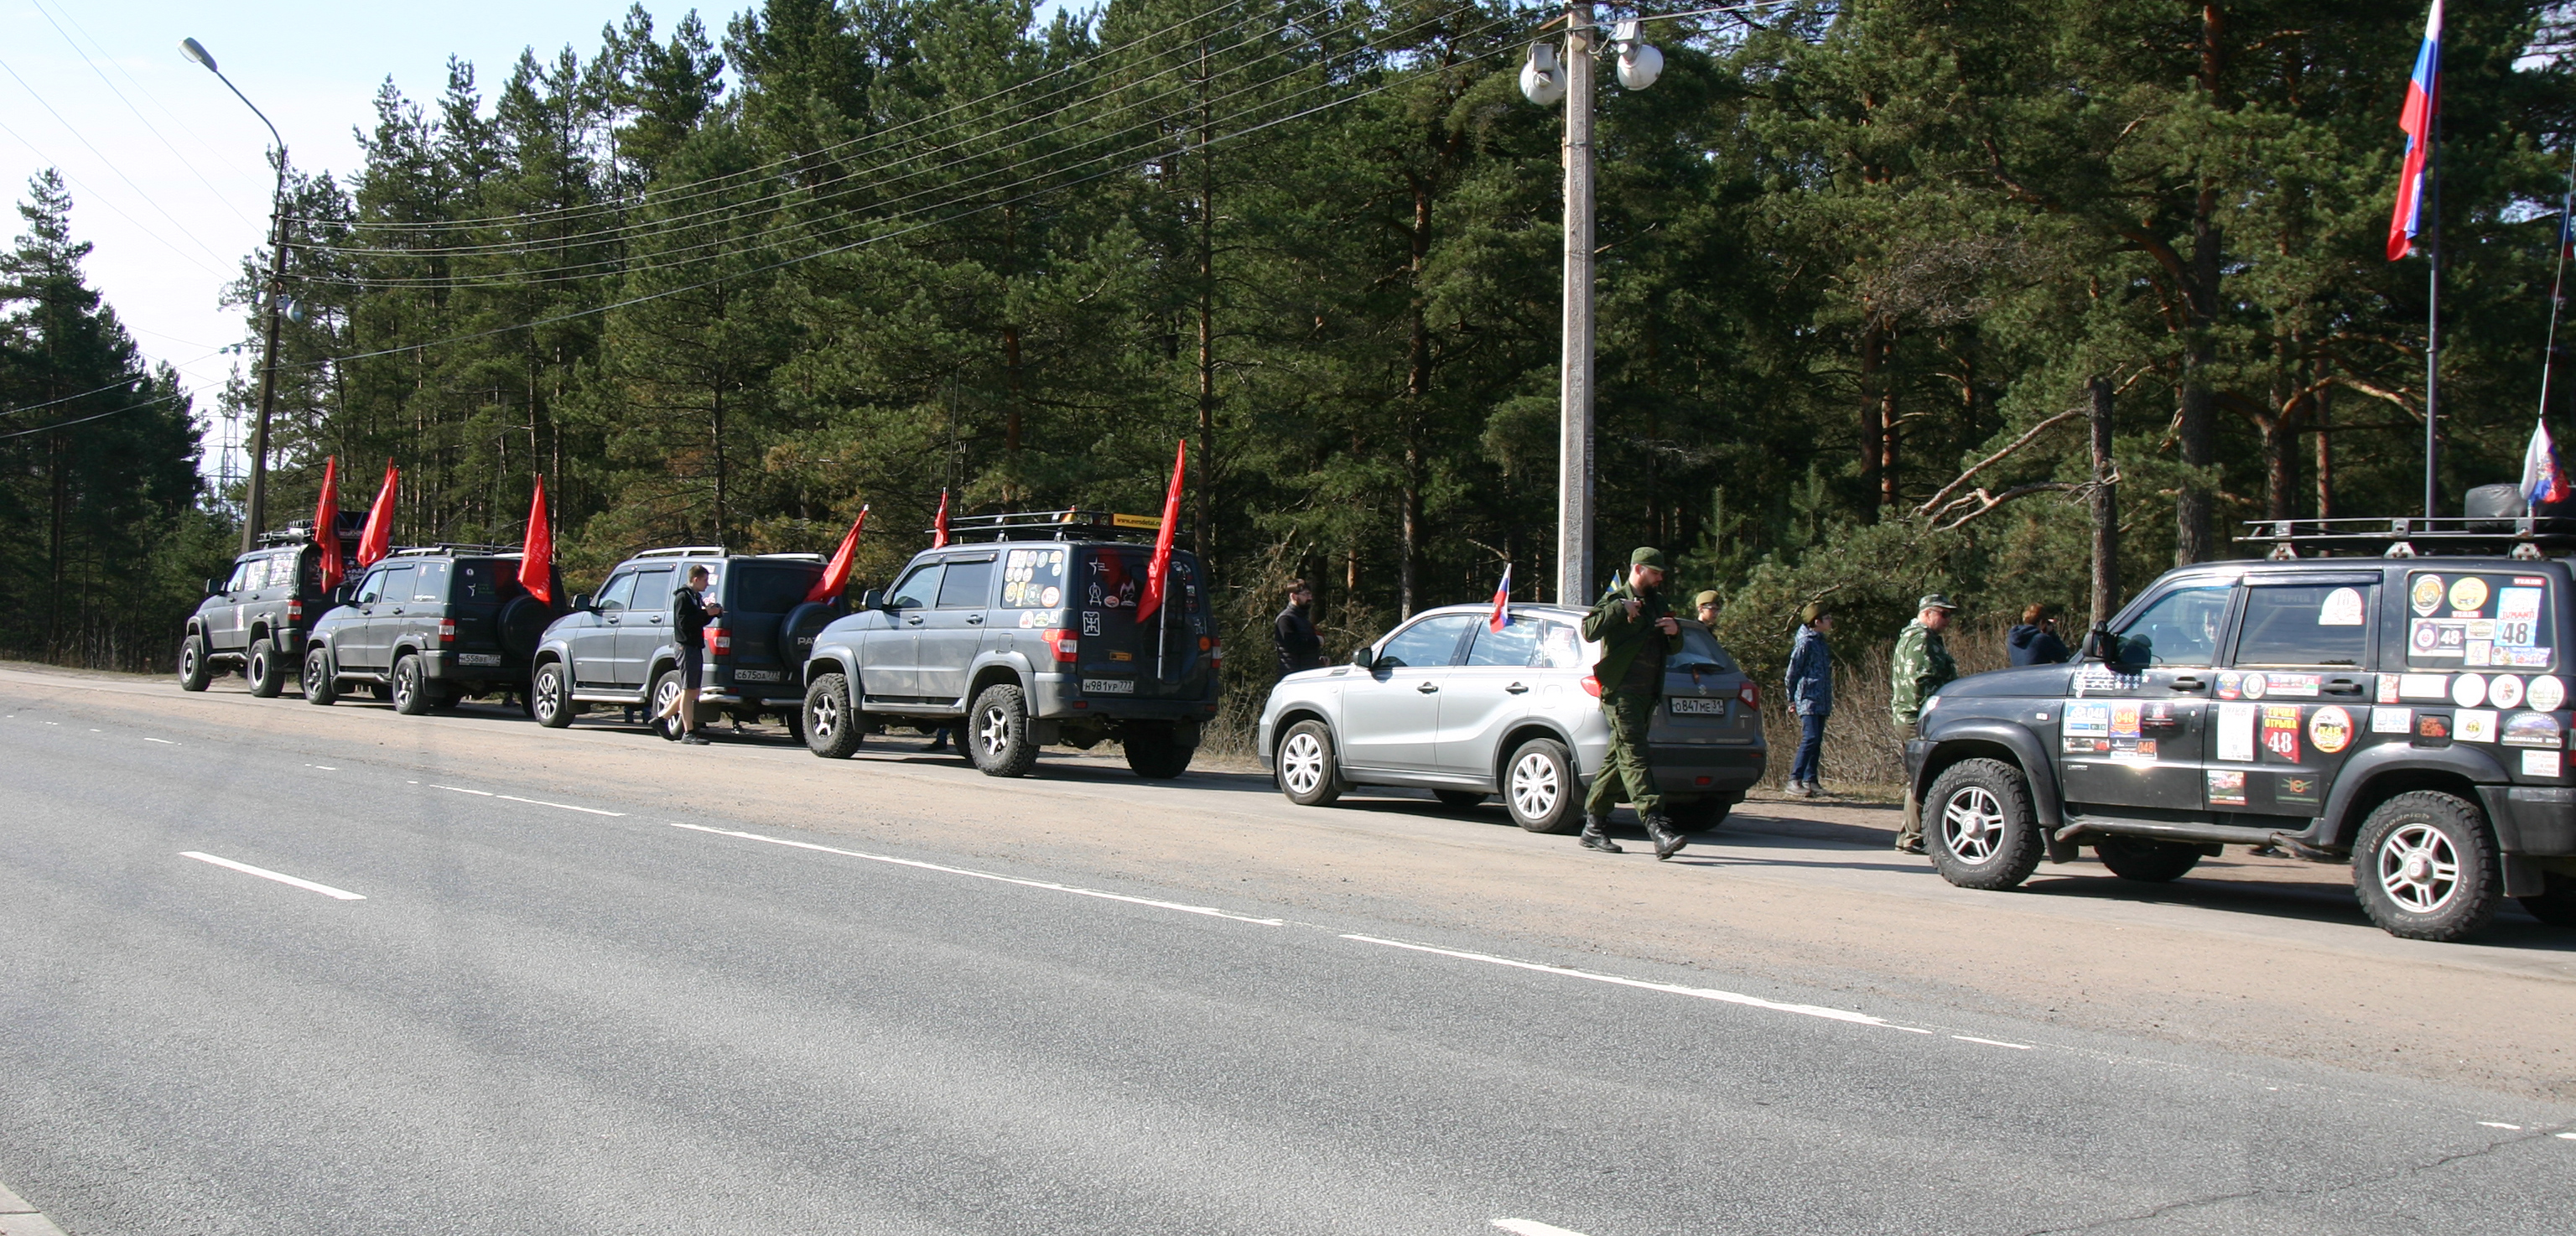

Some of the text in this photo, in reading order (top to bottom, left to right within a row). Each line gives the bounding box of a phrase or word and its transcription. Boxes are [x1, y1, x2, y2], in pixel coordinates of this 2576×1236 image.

[2440, 630, 2460, 645] 48
[2501, 623, 2528, 645] 48
[1085, 681, 1132, 691] Н981УР 777
[1675, 699, 1722, 712] О847МЕ 31
[2116, 711, 2135, 723] 048
[2265, 718, 2298, 729] ОТРЫВА
[2318, 726, 2341, 737] 048
[2138, 741, 2154, 753] 048
[2267, 731, 2293, 753] 48
